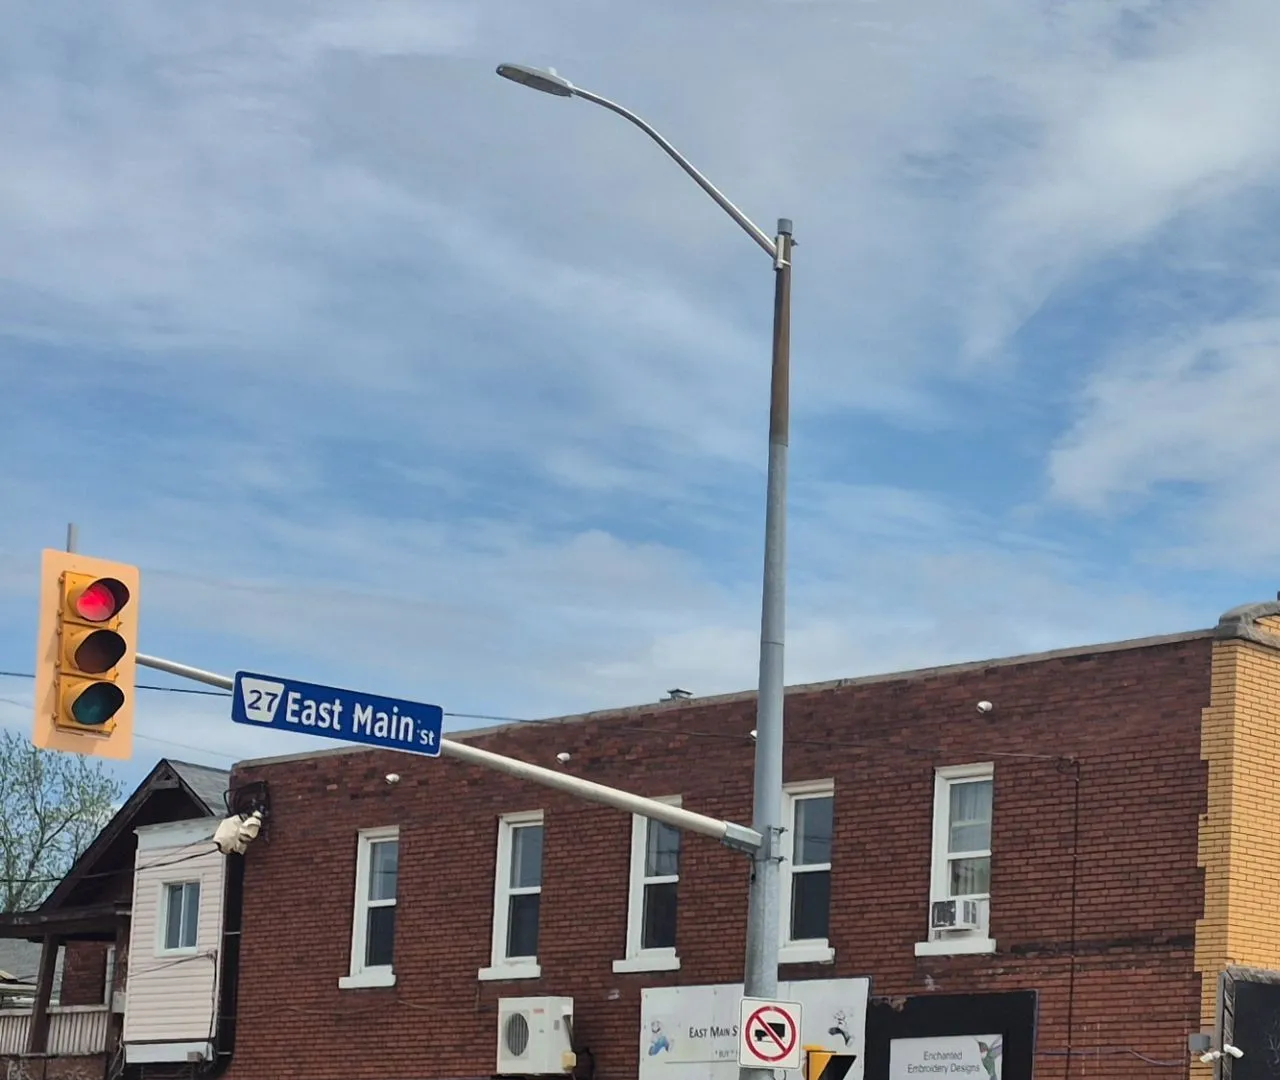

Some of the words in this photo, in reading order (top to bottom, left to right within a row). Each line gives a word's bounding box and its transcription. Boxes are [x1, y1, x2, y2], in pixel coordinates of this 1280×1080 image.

[248, 689, 278, 713] 27
[285, 691, 343, 731] East
[352, 703, 414, 742] Main
[689, 1026, 708, 1038] EAST
[710, 1026, 730, 1039] MAIN
[923, 1050, 963, 1061] Enchanted
[907, 1064, 948, 1074] Embroidery
[950, 1063, 981, 1074] Designs
